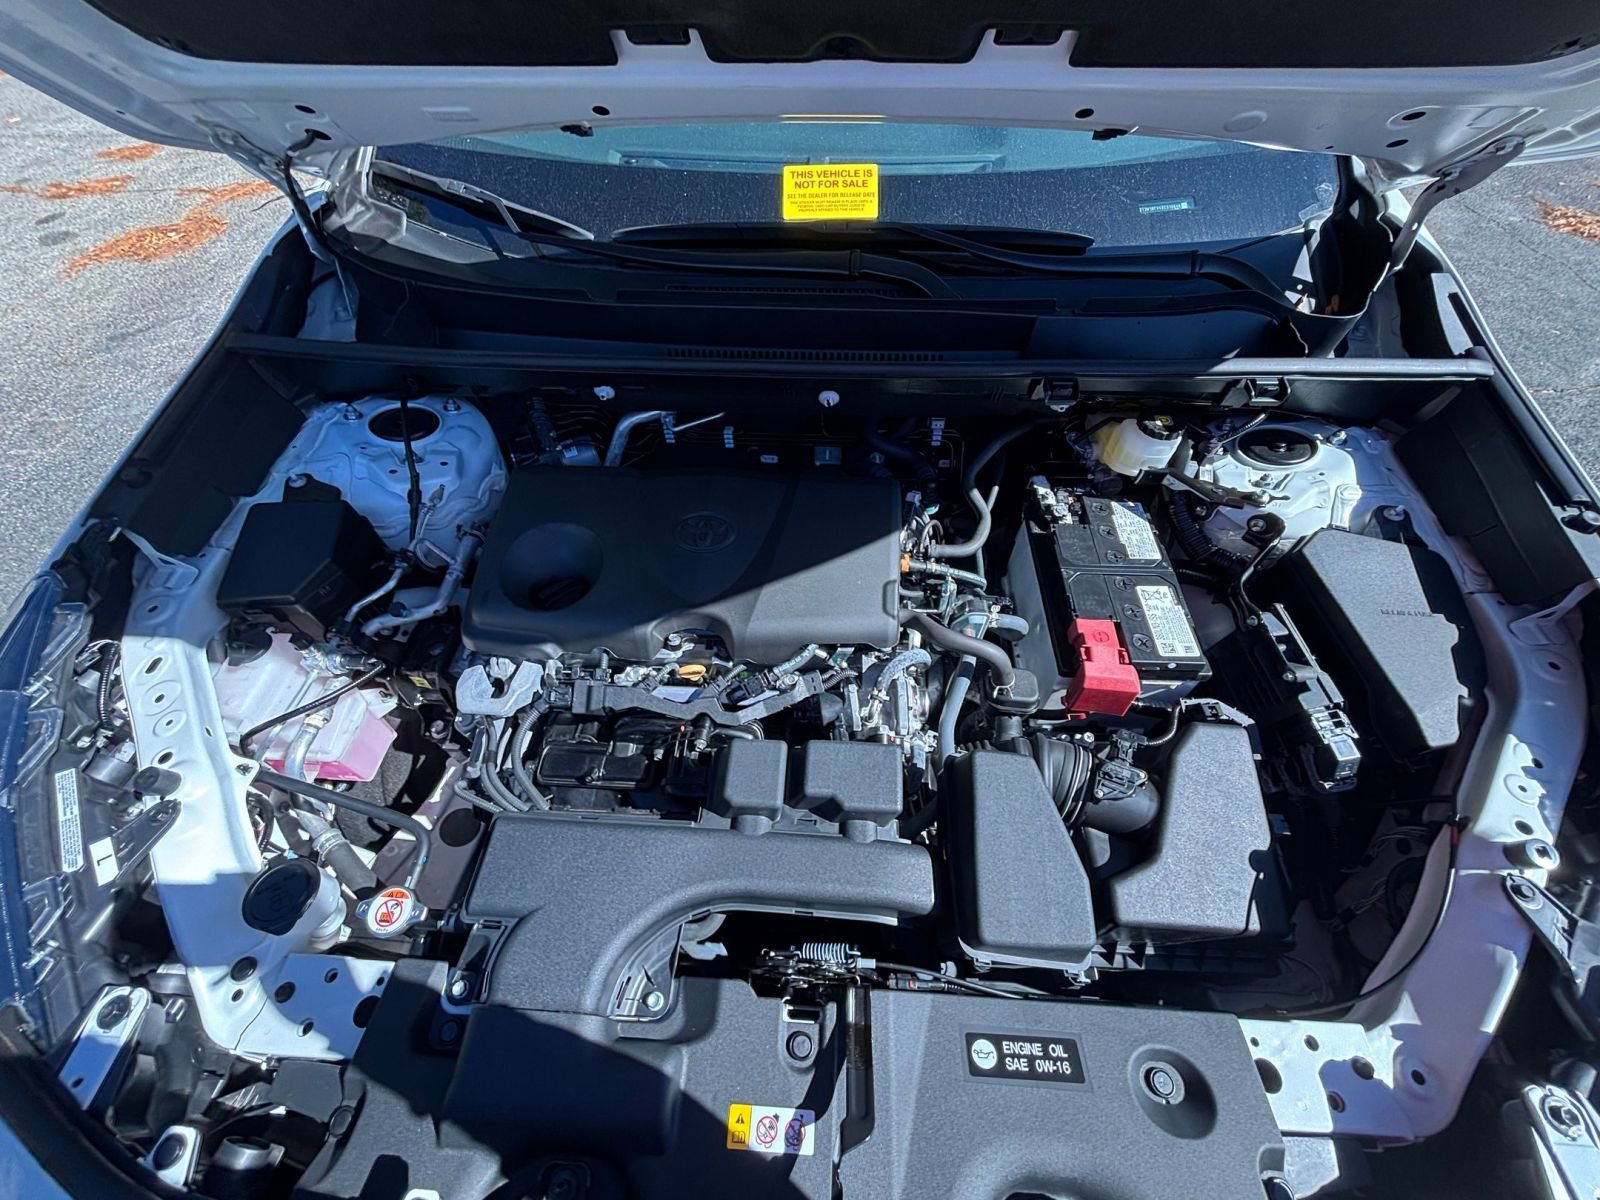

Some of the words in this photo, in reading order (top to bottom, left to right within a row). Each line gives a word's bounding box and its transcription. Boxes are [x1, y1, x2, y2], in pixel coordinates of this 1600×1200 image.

[790, 170, 814, 179] THIS
[816, 169, 860, 178] VEHICLE
[863, 169, 873, 178] IS
[794, 180, 816, 189] NOT
[818, 180, 839, 189] FOR
[841, 179, 869, 188] SALE
[1002, 1041, 1043, 1056] ENGINE
[1048, 1044, 1068, 1057] OIL
[1005, 1057, 1029, 1072] SAE
[1035, 1059, 1071, 1075] 0W-16
